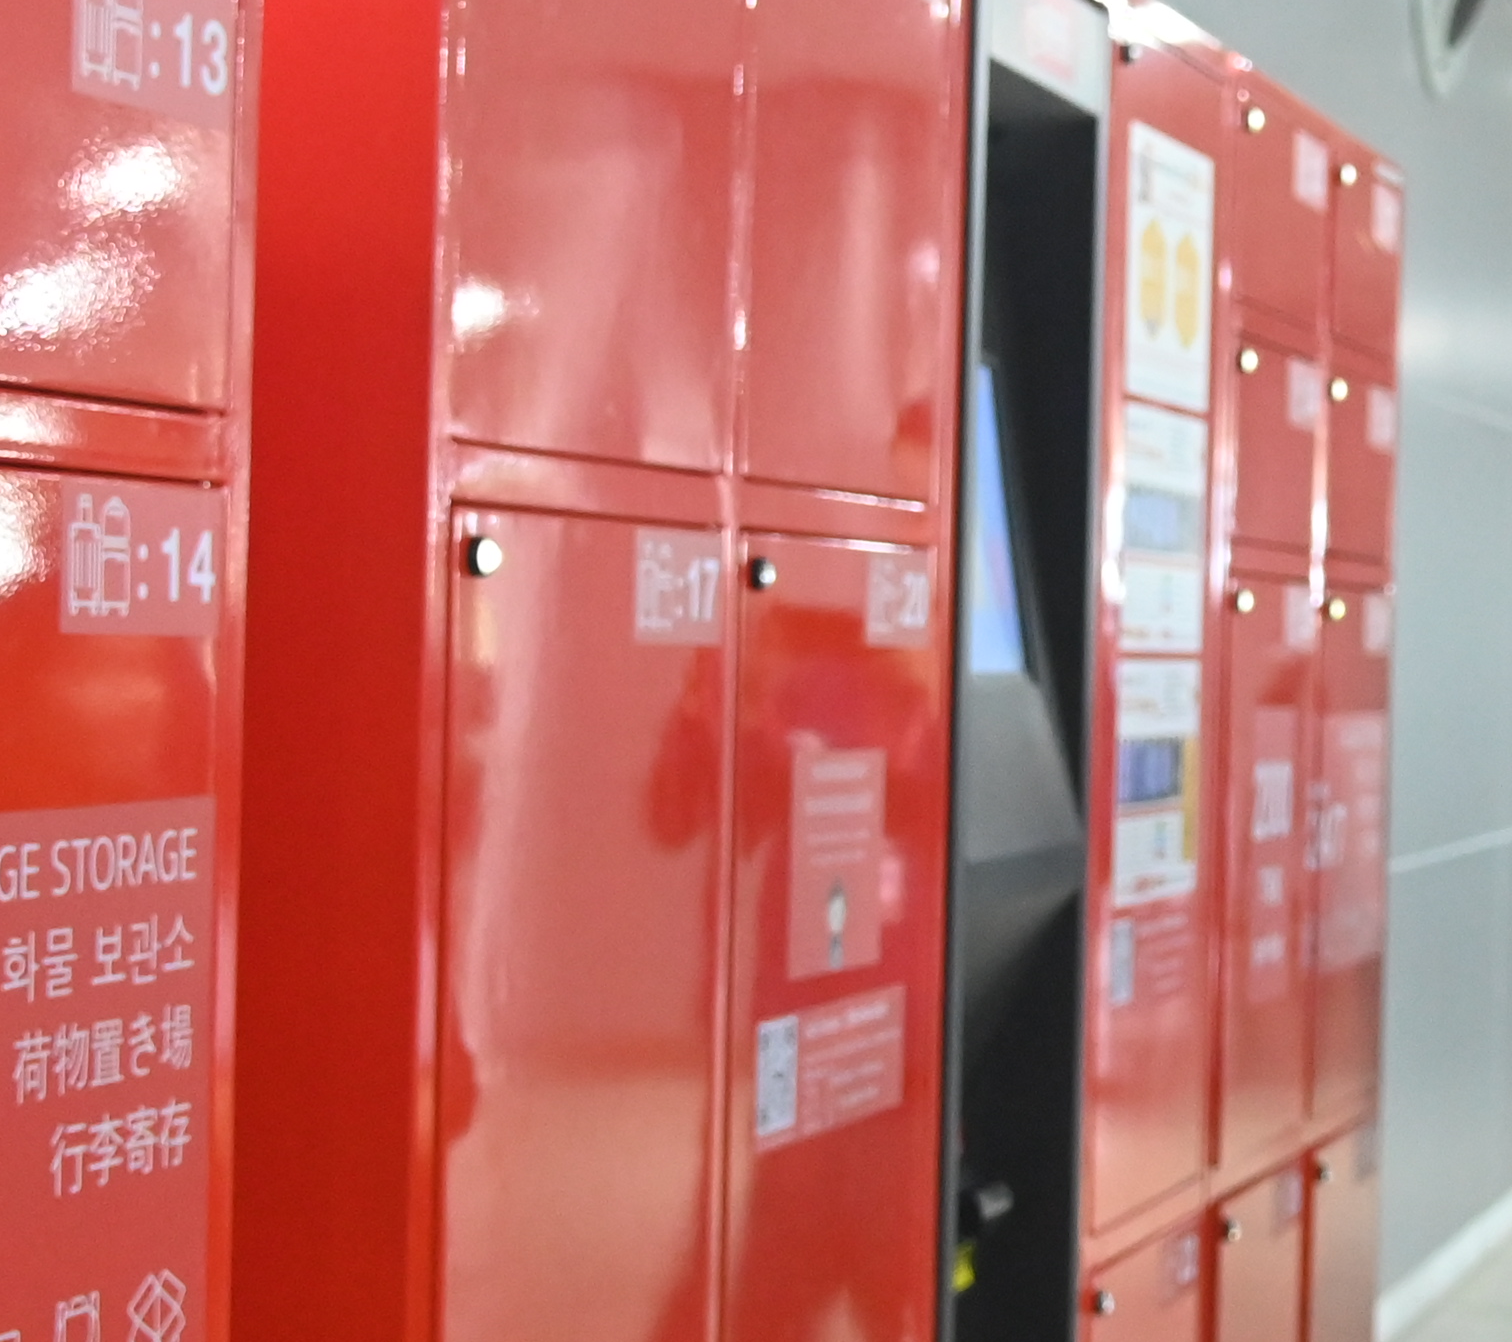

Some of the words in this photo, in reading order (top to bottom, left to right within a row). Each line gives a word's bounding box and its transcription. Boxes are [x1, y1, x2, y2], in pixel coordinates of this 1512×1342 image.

[51, 826, 199, 897] STORAGE
[0, 925, 79, 1003] 화물
[90, 913, 196, 988] 보관소
[11, 1003, 194, 1105] 荷物置き場
[49, 1097, 193, 1198] 行李寄存
